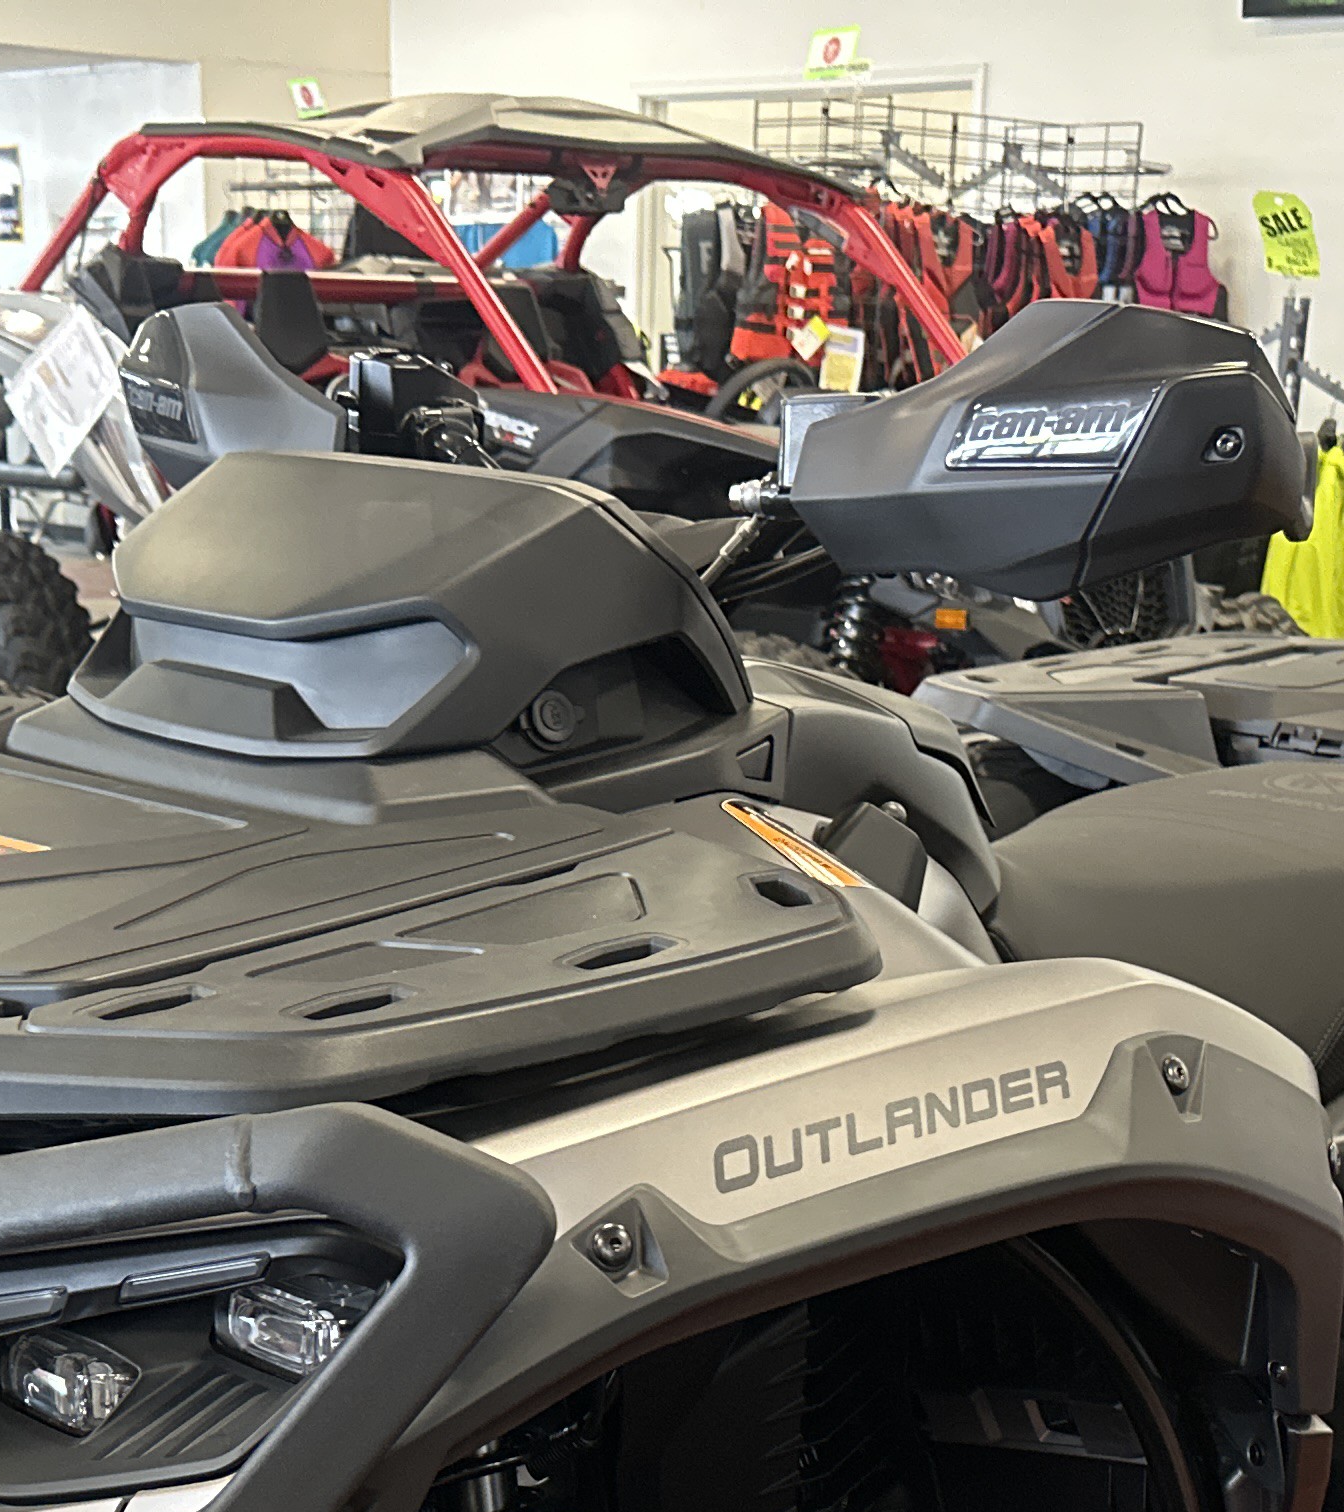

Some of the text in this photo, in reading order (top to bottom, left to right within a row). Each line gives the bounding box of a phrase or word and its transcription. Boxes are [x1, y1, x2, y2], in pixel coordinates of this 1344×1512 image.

[1259, 207, 1308, 238] SALE
[968, 402, 1131, 442] can-am
[713, 1060, 1071, 1194] OUTLANDER
